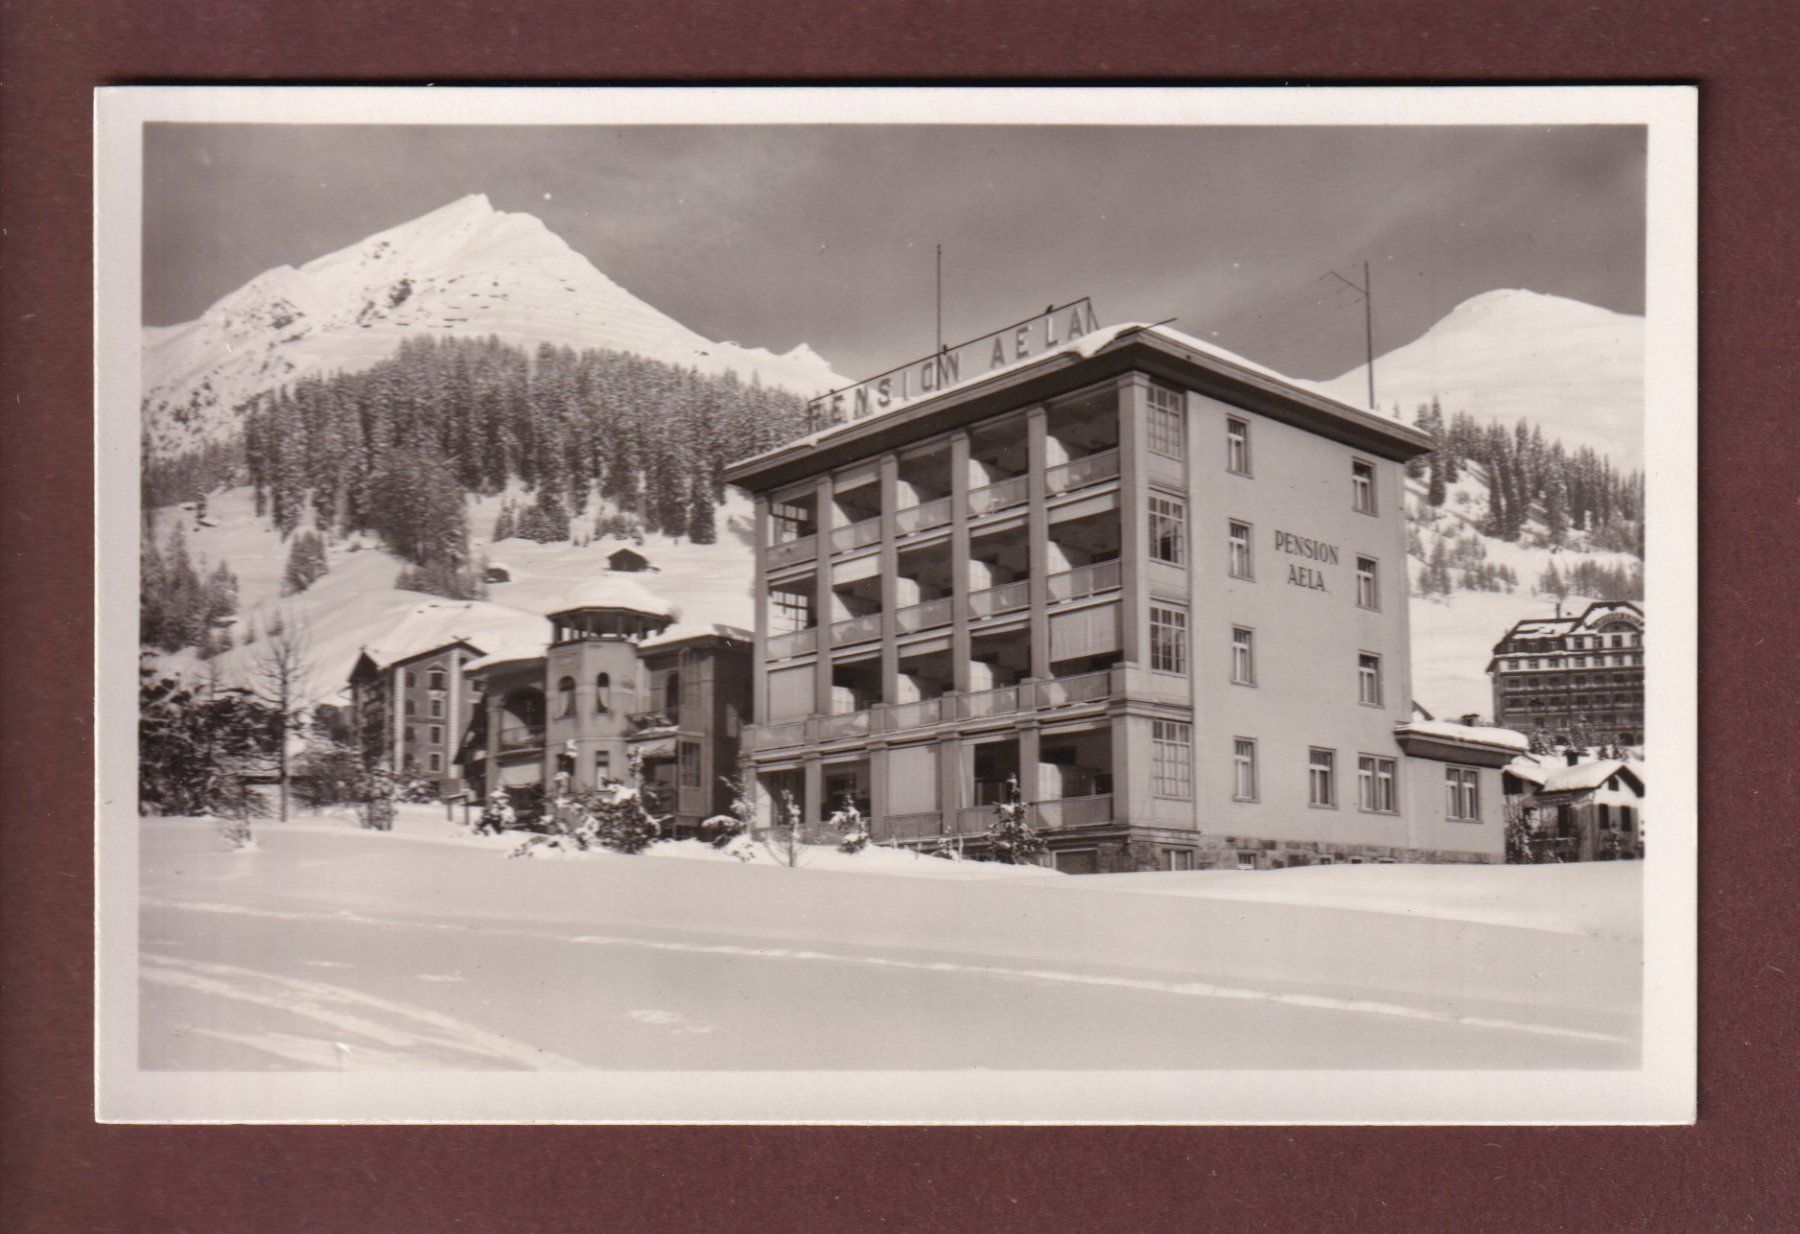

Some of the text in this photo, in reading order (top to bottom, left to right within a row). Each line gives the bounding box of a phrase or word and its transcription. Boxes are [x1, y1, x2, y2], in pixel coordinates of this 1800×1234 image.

[808, 306, 1084, 432] PENSION AELA
[1274, 529, 1339, 565] PENSION
[1287, 564, 1327, 592] AELA
